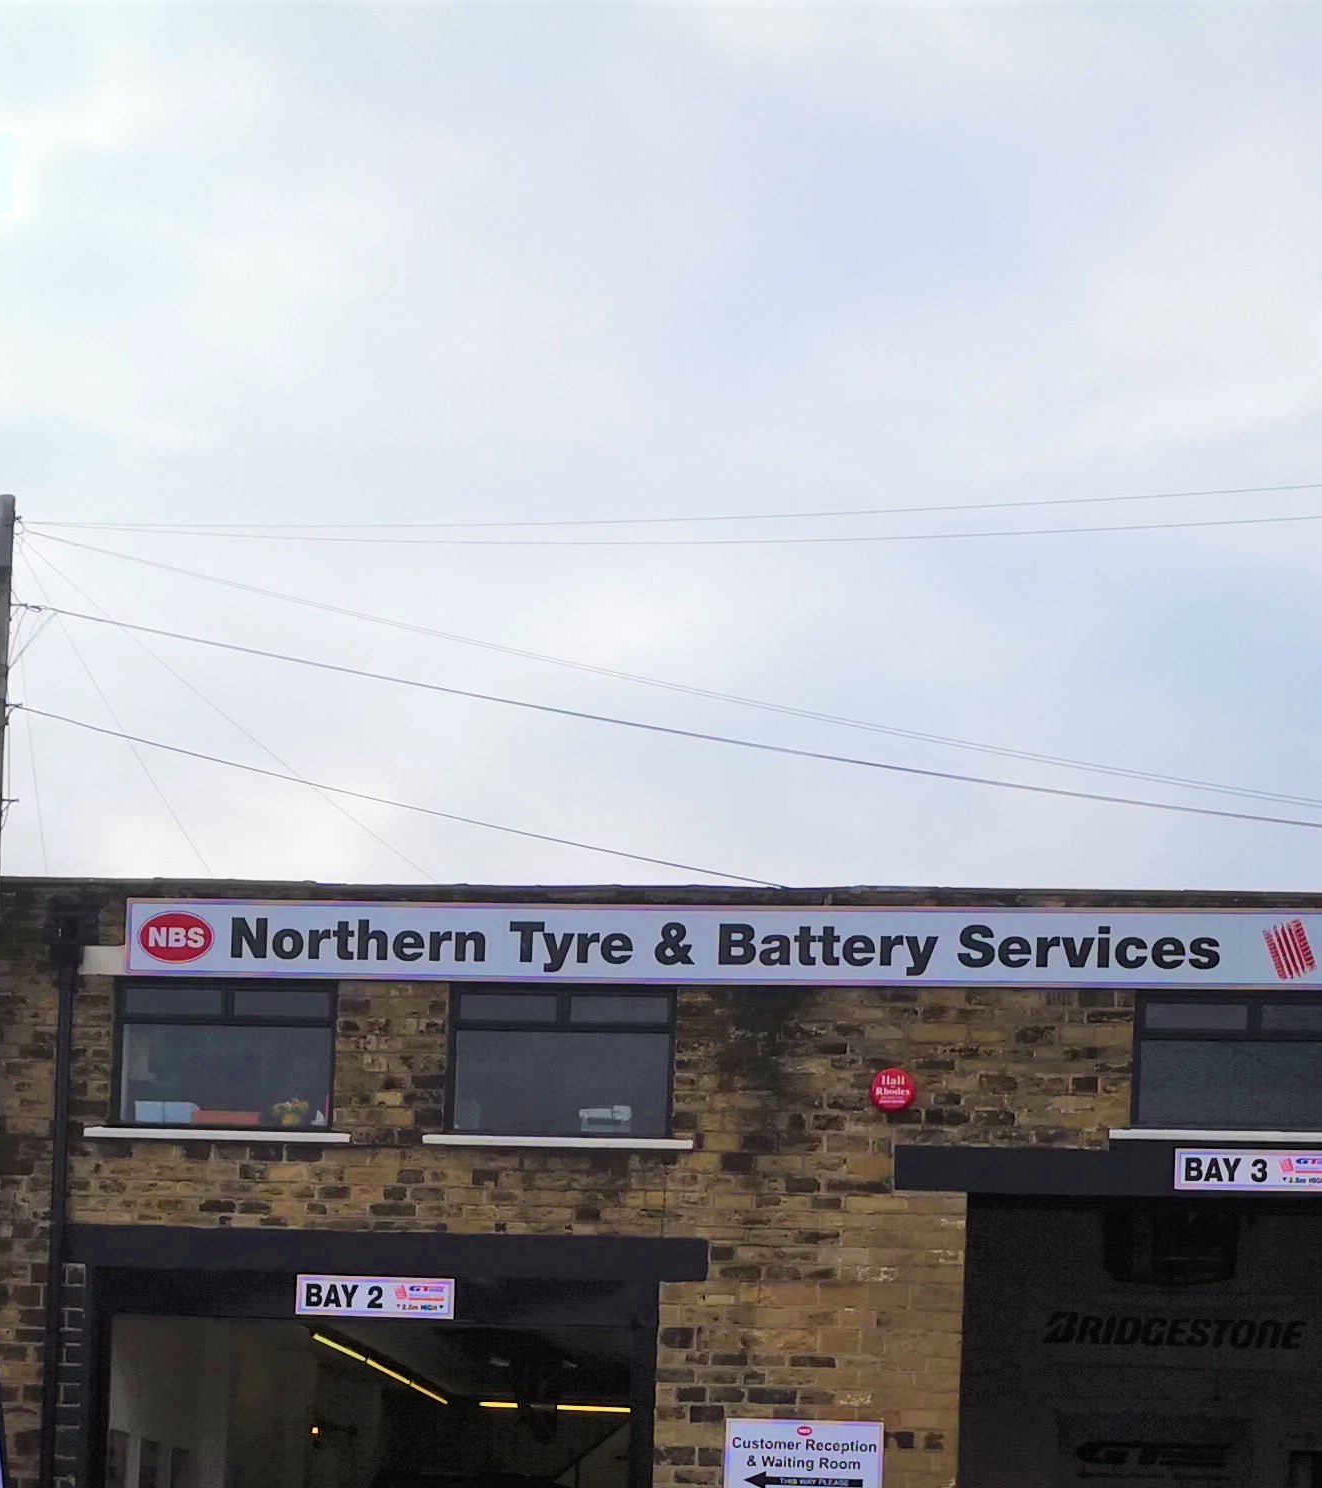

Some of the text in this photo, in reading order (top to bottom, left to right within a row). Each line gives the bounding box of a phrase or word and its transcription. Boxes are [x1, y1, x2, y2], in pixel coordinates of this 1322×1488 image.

[148, 926, 206, 949] NBS
[230, 917, 1221, 976] Northern Tyre & Battery Services
[876, 1086, 911, 1096] Rhodes
[881, 1075, 905, 1085] Hall
[1185, 1157, 1268, 1183] BAY 3
[305, 1283, 384, 1309] BAY 2
[1043, 1311, 1307, 1349] BRIDGESTONE
[732, 1437, 877, 1454] Customer Reception
[747, 1455, 861, 1471] & Waiting Room
